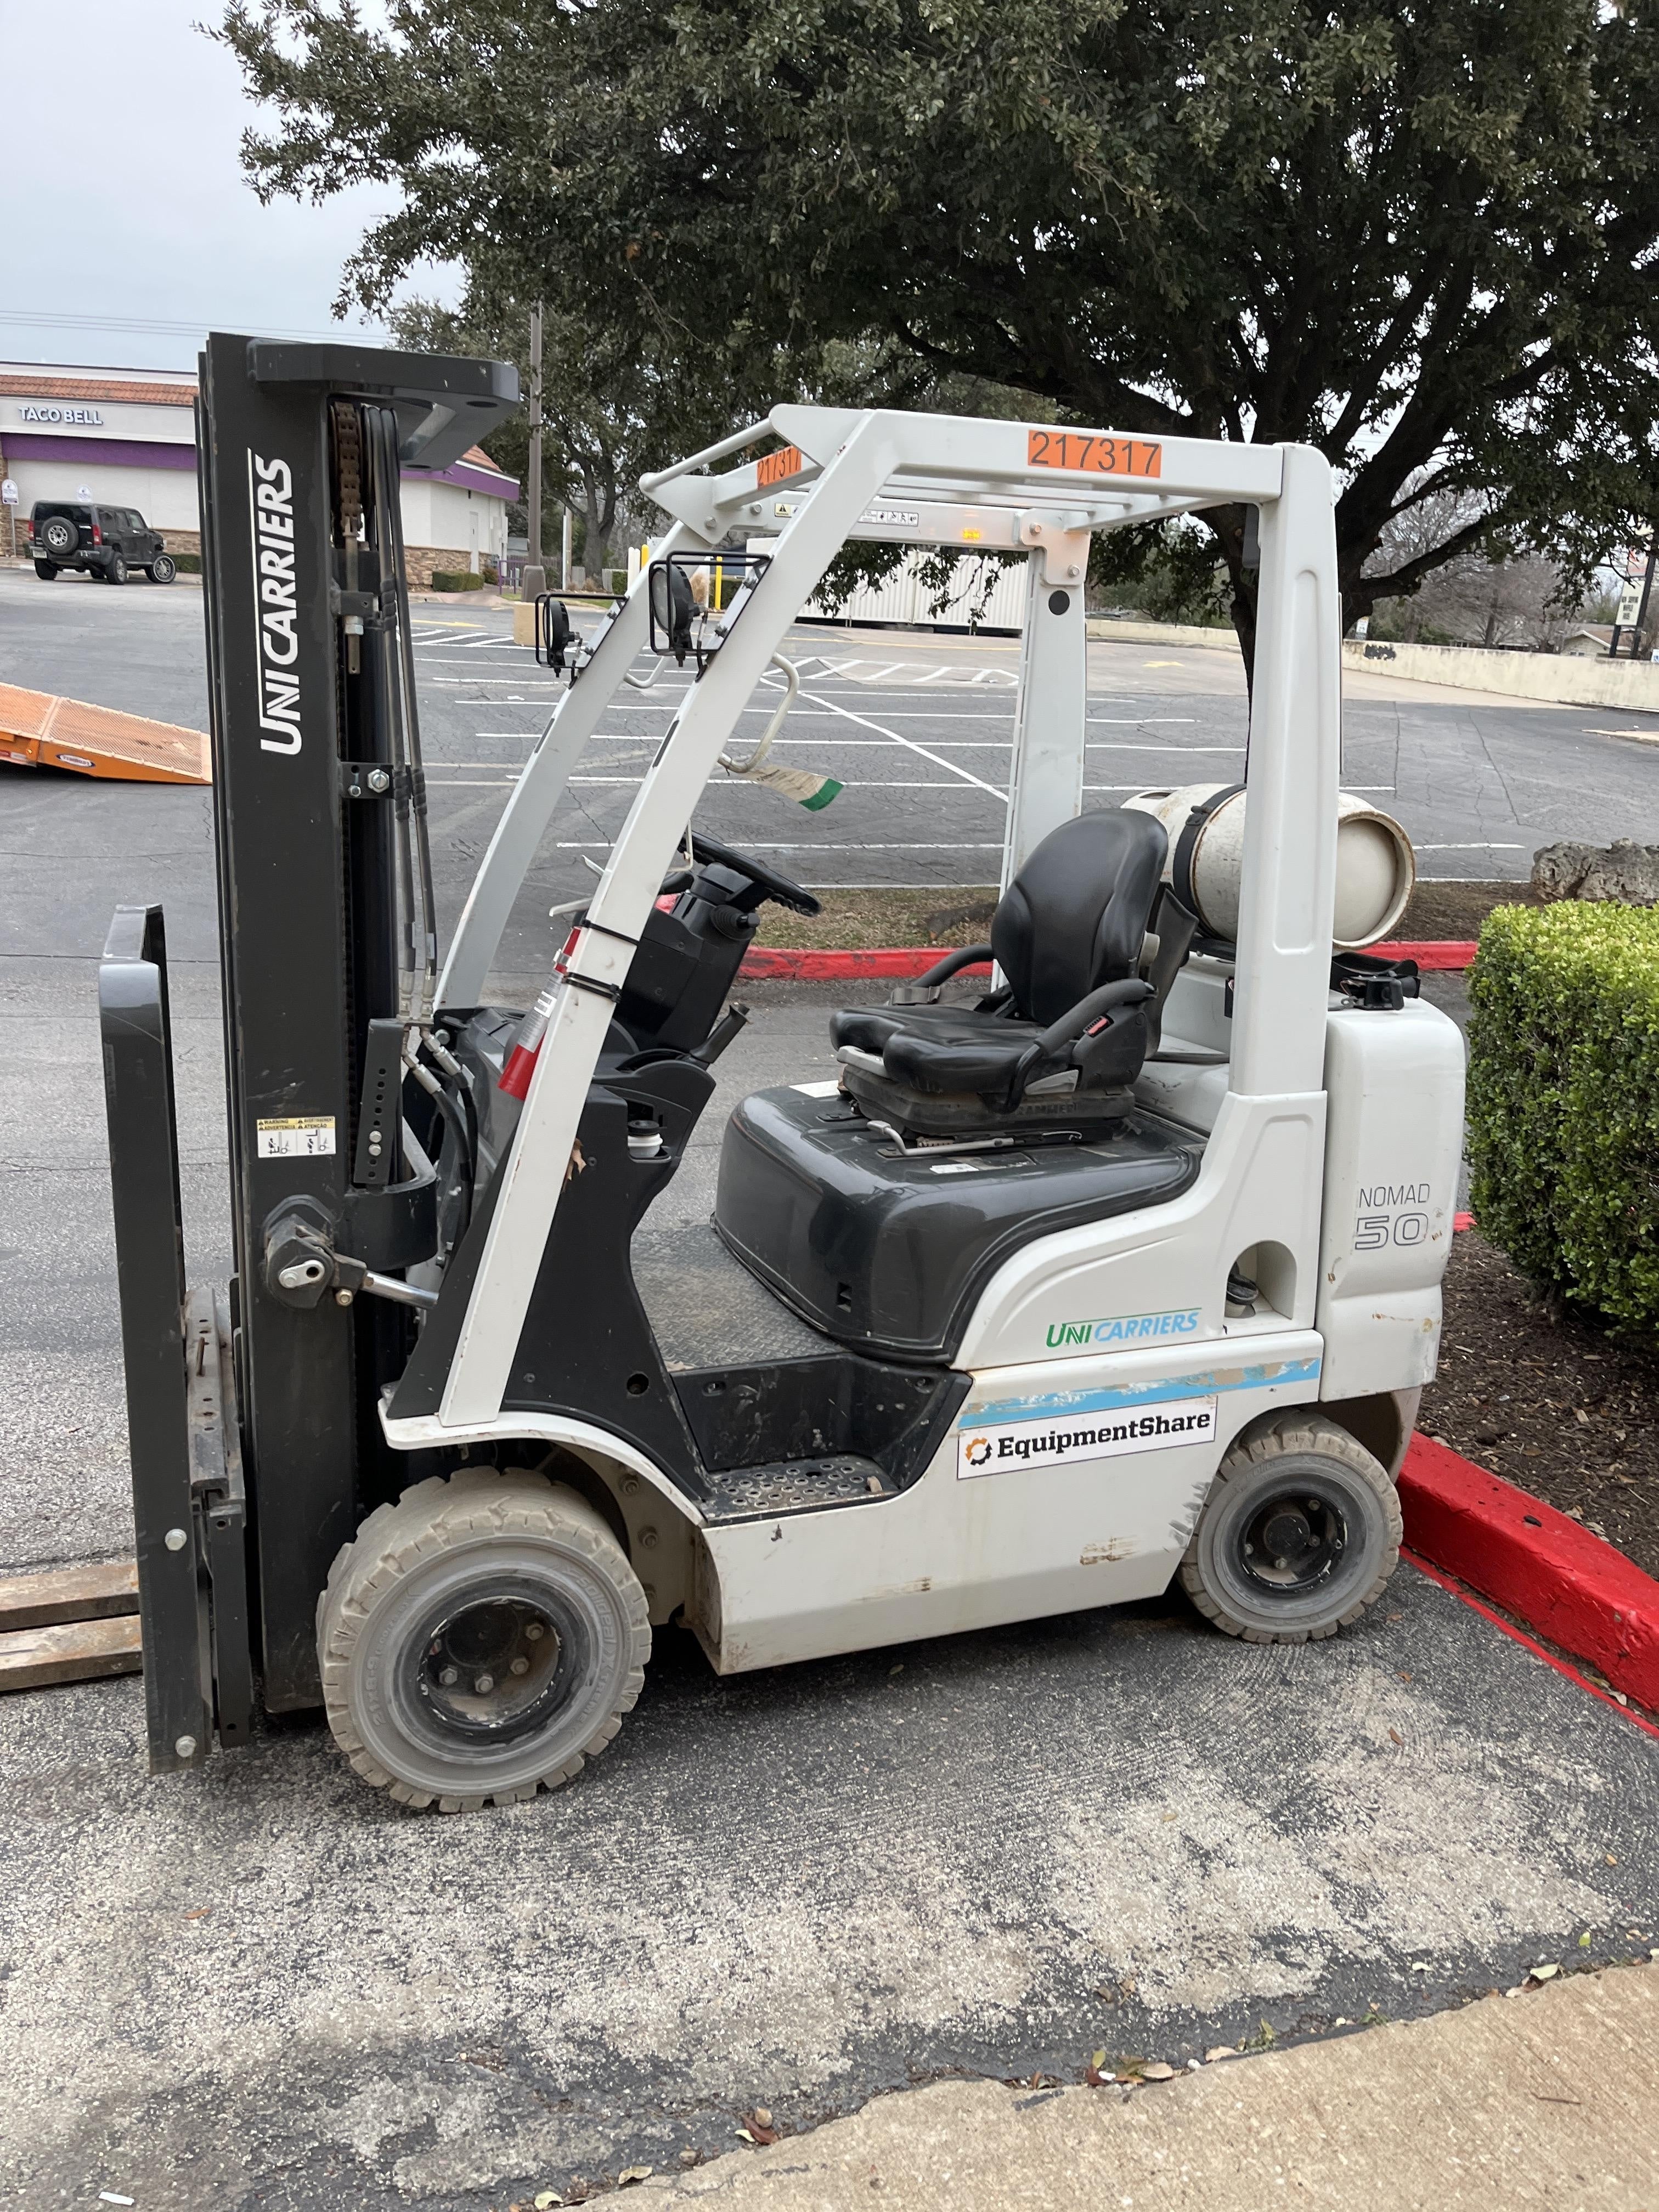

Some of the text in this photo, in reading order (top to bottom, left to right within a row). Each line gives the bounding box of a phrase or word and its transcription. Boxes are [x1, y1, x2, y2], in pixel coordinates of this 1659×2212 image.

[18, 407, 104, 425] TACO BELL
[1031, 431, 1160, 475] 217317
[1359, 1183, 1430, 1208] NOMAD
[1355, 1212, 1429, 1250] 50
[997, 1413, 1211, 1460] EquipmentShare
